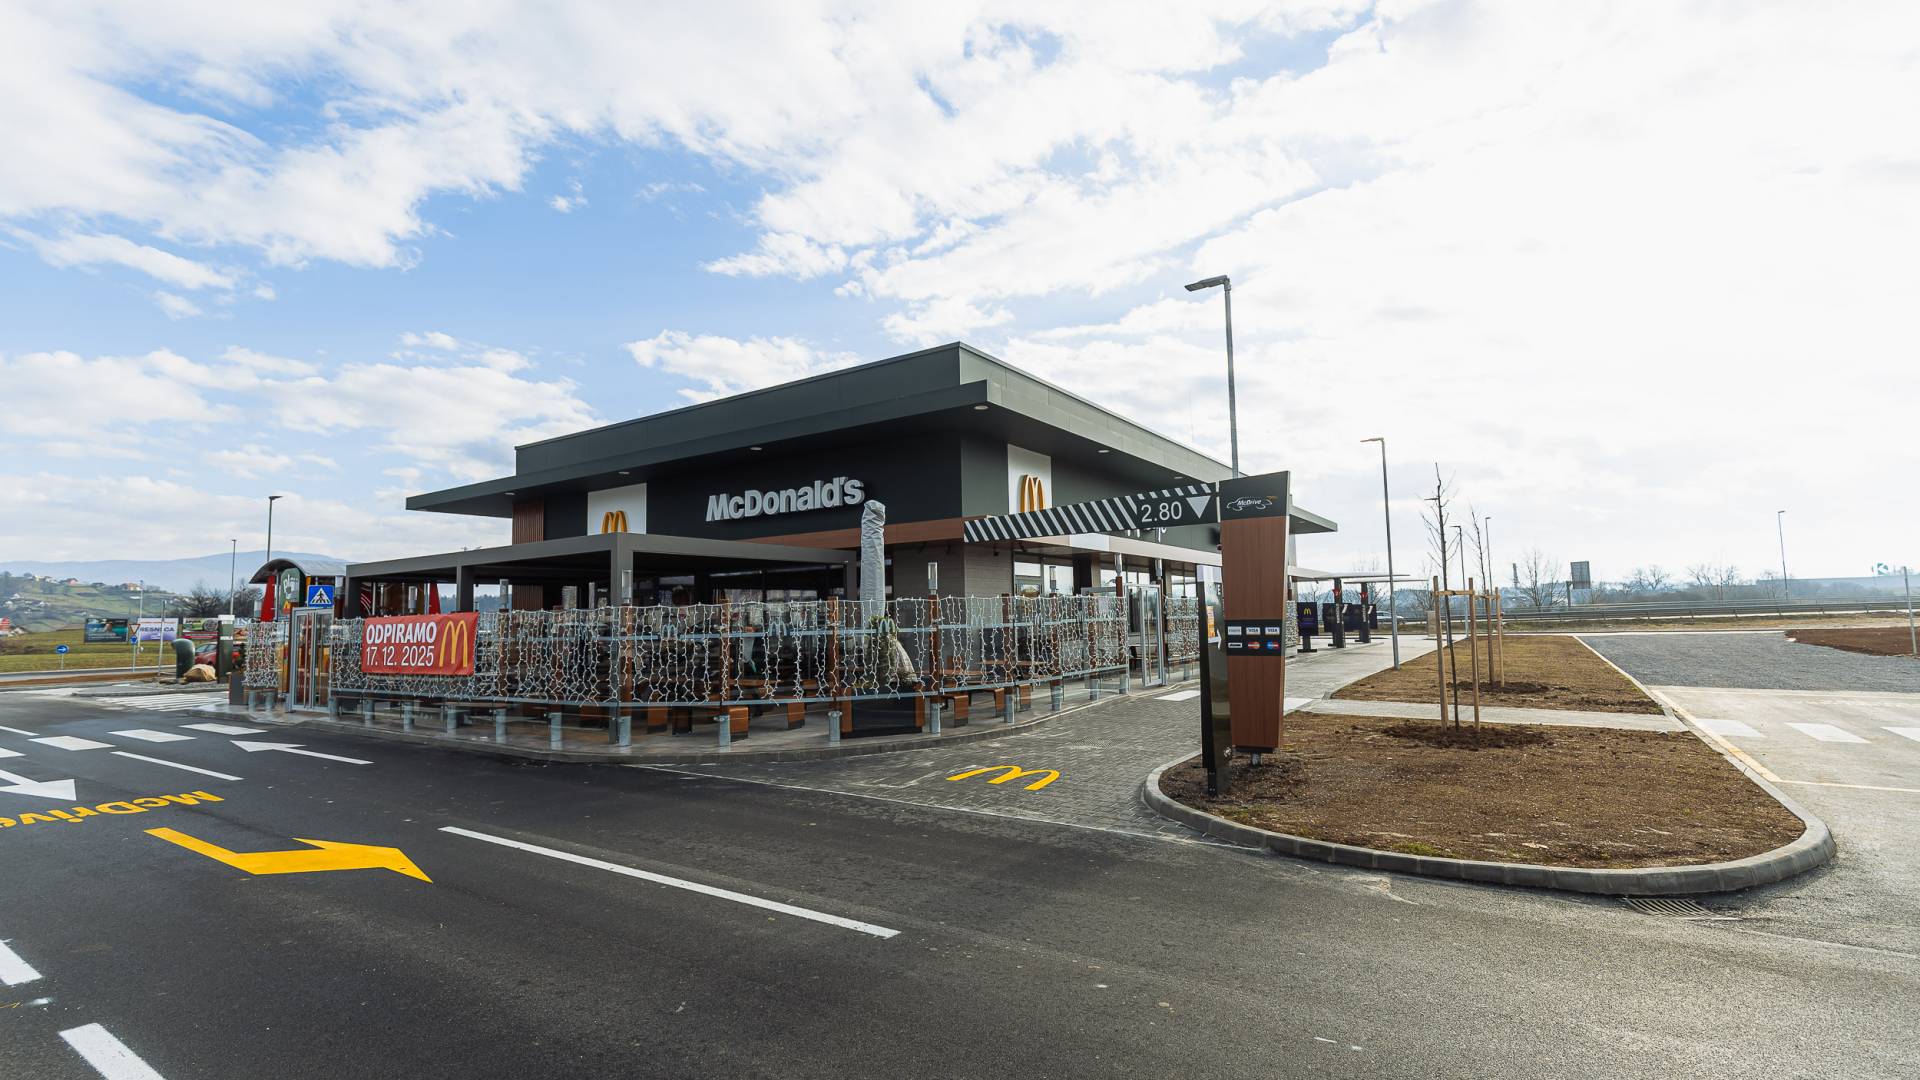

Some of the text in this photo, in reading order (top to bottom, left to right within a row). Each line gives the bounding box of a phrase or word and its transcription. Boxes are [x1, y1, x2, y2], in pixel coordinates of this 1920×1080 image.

[705, 476, 865, 522] McDonald's
[1141, 501, 1182, 523] 2.80
[366, 621, 437, 644] ODPIRAMO
[366, 645, 435, 667] 17. 12. 2025
